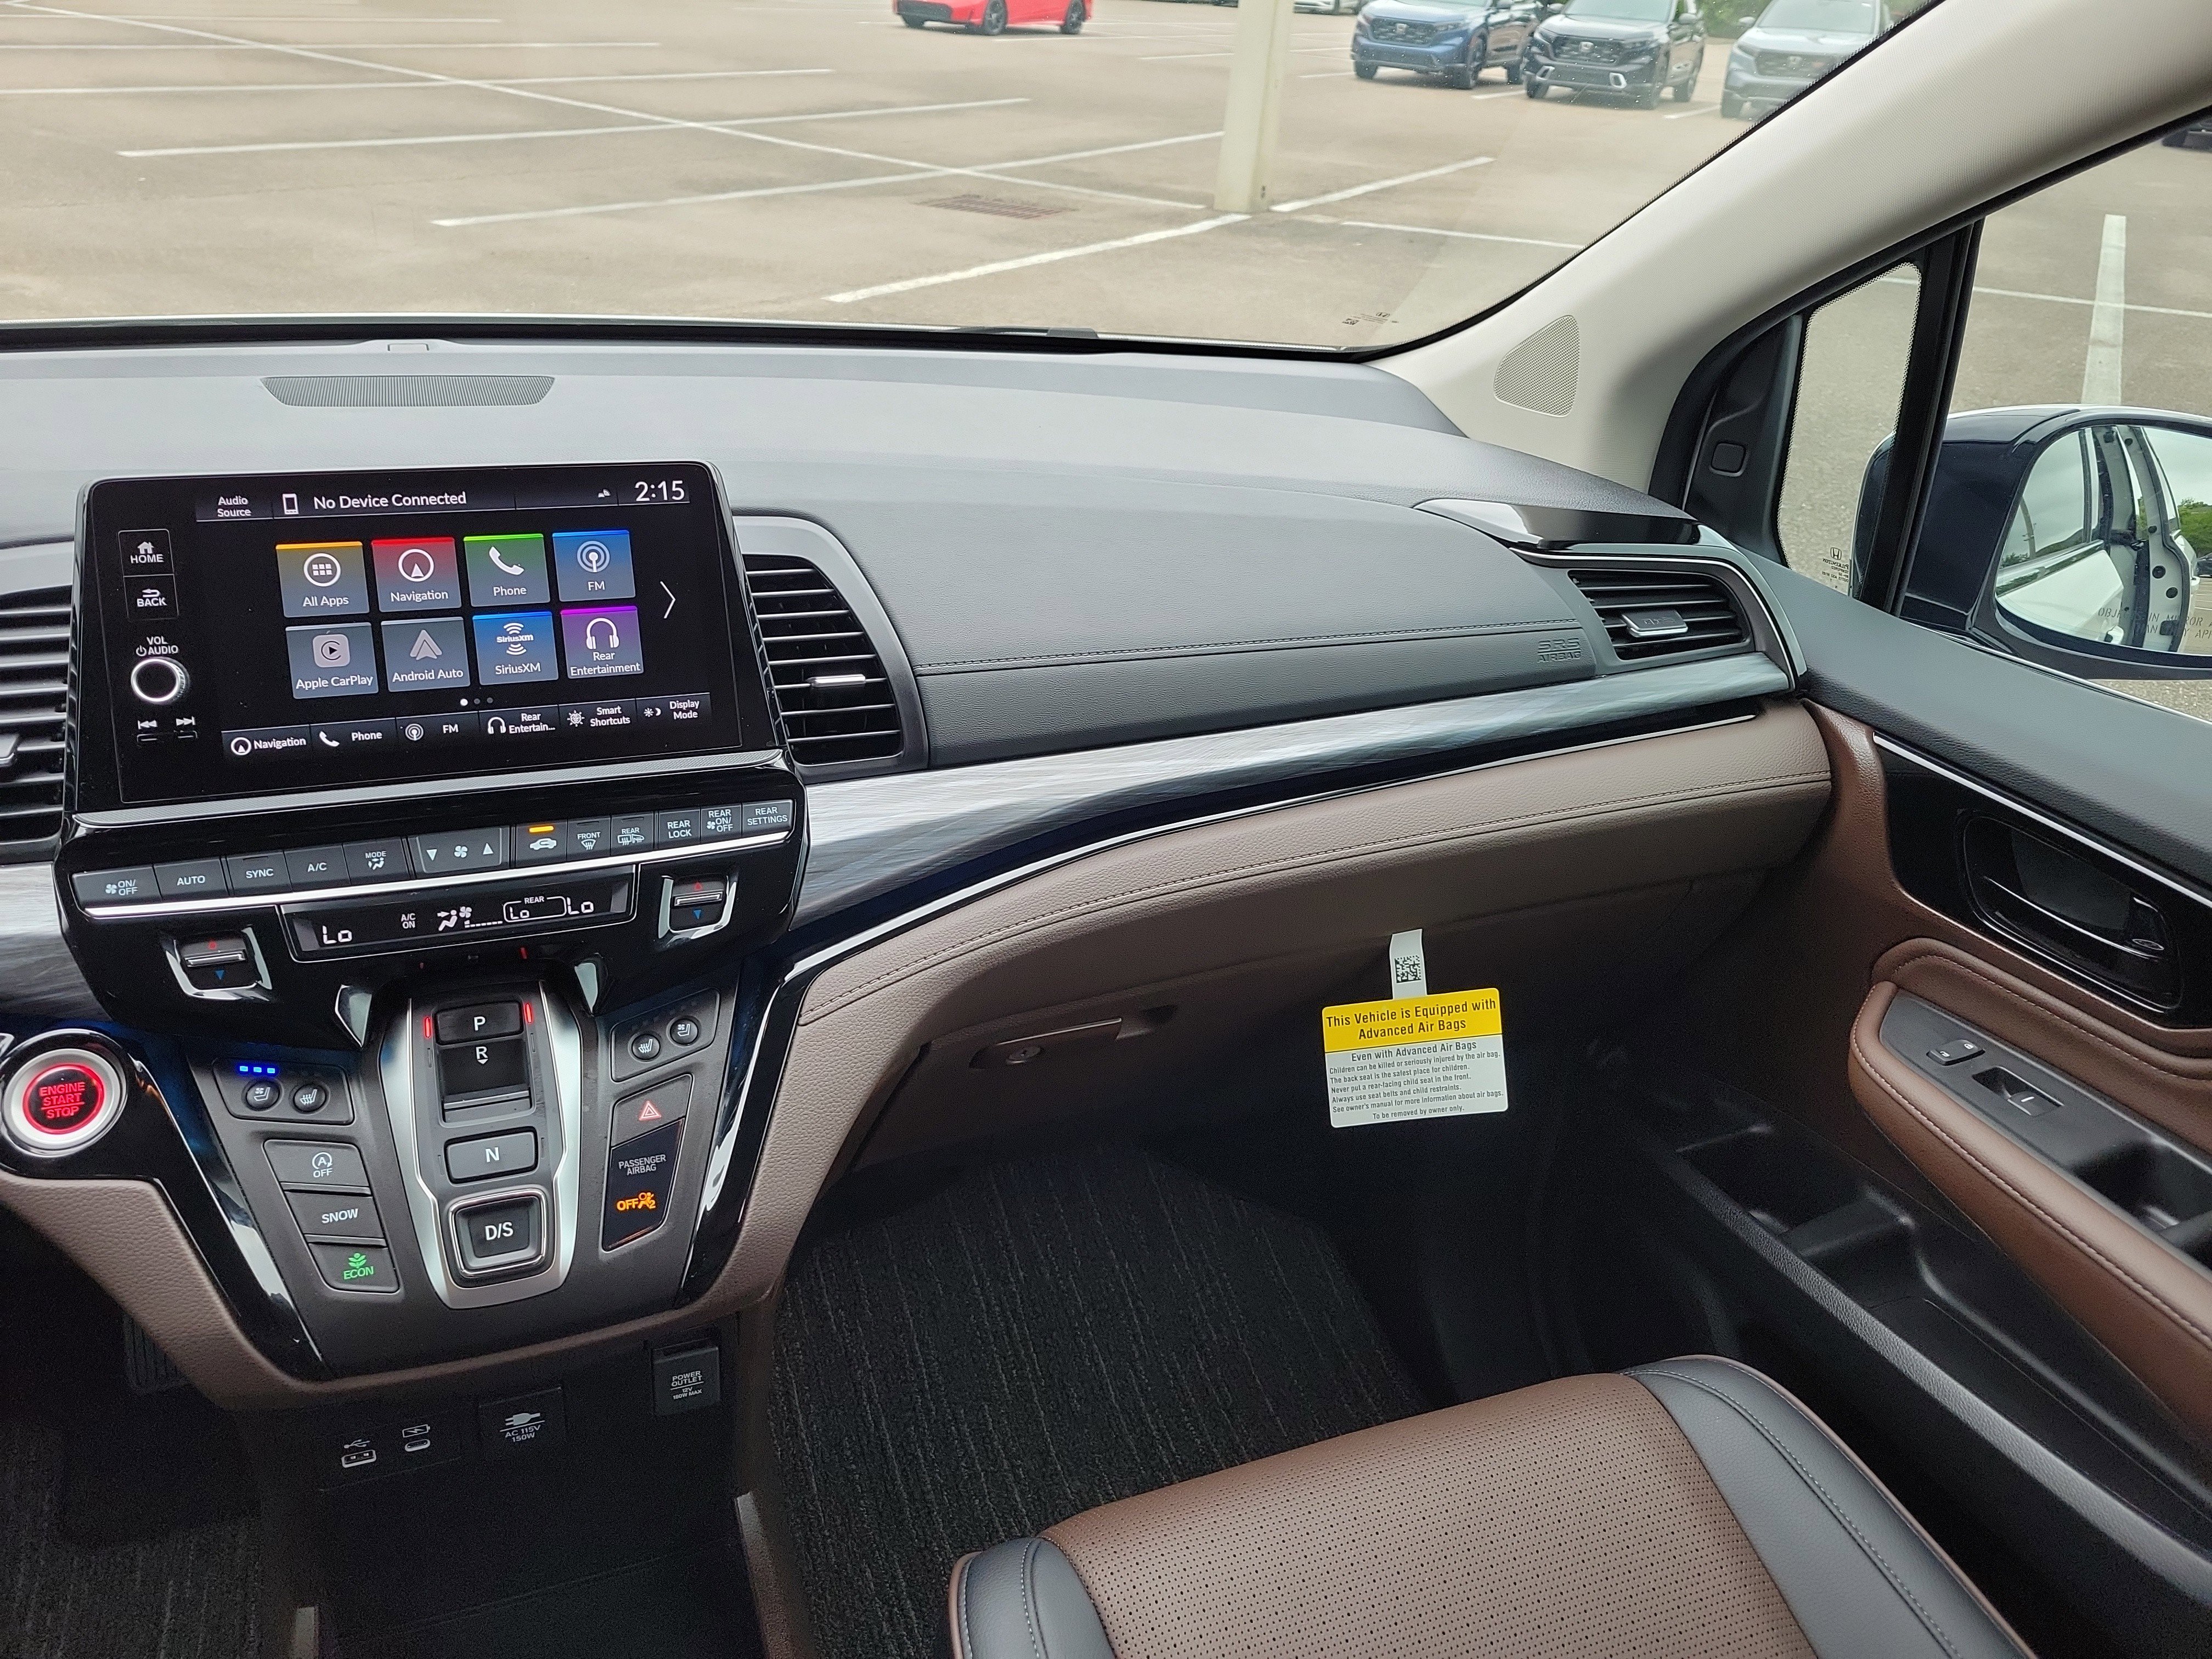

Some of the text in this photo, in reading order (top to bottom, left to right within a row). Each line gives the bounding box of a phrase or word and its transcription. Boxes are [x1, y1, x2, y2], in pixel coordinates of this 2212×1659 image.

[635, 480, 685, 503] 2:15
[218, 495, 249, 506] Audio
[314, 492, 466, 509] No Device Connected
[217, 507, 251, 517] Source
[130, 553, 163, 563] HOME
[493, 585, 527, 596] Phone
[588, 580, 605, 591] FM
[137, 596, 167, 607] BACK
[303, 595, 349, 608] All Apps
[390, 589, 448, 602] Navigation
[146, 636, 167, 645] VOL
[1538, 637, 1580, 651] SRS
[148, 645, 178, 655] AUDIO
[593, 651, 615, 661] Rear
[1537, 651, 1581, 663] AIRBAG
[495, 662, 541, 674] SiriusXM
[571, 662, 640, 676] Entertainment
[392, 668, 464, 682] Android Auto
[296, 674, 373, 690] Apple CarPlay
[596, 706, 622, 716] Smart
[669, 699, 699, 712] Display
[521, 712, 541, 721] Rear
[673, 709, 698, 720] Mode
[590, 715, 630, 727] Shortcuts
[443, 724, 459, 733] FM
[509, 723, 555, 733] Entertain...
[351, 730, 382, 741] Phone
[253, 737, 306, 751] Navigation
[708, 809, 731, 819] REAR
[755, 806, 777, 816] REAR
[667, 820, 691, 830] REAR
[715, 816, 732, 825] ON/
[747, 814, 787, 826] SETTINGS
[668, 828, 692, 838] LOCK
[716, 823, 733, 832] OFF
[577, 832, 601, 841] FRONT
[307, 862, 327, 872] A/C
[246, 868, 274, 879] SYNC
[118, 879, 137, 889] ON/
[177, 874, 205, 886] AUTO
[119, 886, 138, 895] OFF
[524, 896, 544, 904] REAR
[510, 906, 529, 919] Lo
[567, 898, 594, 915] Lo
[401, 913, 416, 922] A/C
[402, 920, 416, 929] ON
[322, 926, 352, 944] Lo
[1326, 998, 1496, 1028] This Vehicle is Equipped with
[474, 1017, 486, 1031] P
[1359, 1020, 1466, 1040] Advanced Air Bags
[476, 1046, 488, 1060] R
[1352, 1042, 1477, 1062] Even with Advanced Air Bags
[1378, 1061, 1395, 1069] killed
[1404, 1057, 1432, 1066] seriously
[1434, 1054, 1455, 1064] injured
[1413, 1068, 1430, 1076] place
[1442, 1064, 1470, 1072] children.
[39, 1081, 85, 1096] ENGINE
[1351, 1085, 1361, 1093] put
[1368, 1081, 1402, 1090] rear-facing
[1430, 1084, 1462, 1093] restraints.
[43, 1092, 82, 1105] START
[1371, 1100, 1393, 1108] manual
[1422, 1094, 1457, 1103] information
[47, 1105, 79, 1119] STOP
[1391, 1108, 1418, 1118] removed
[486, 1147, 499, 1163] N
[618, 1154, 667, 1169] PASSENGER
[313, 1168, 332, 1178] OFF
[627, 1164, 657, 1176] AIRBAG
[617, 1198, 639, 1211] OFF
[321, 1209, 358, 1223] SNOW
[485, 1222, 514, 1240] D/S
[343, 1266, 374, 1279] ECON
[672, 1370, 701, 1381] POWER
[672, 1375, 702, 1386] OUTLET
[505, 1424, 541, 1438] AC 115V
[512, 1432, 535, 1442] 150W
